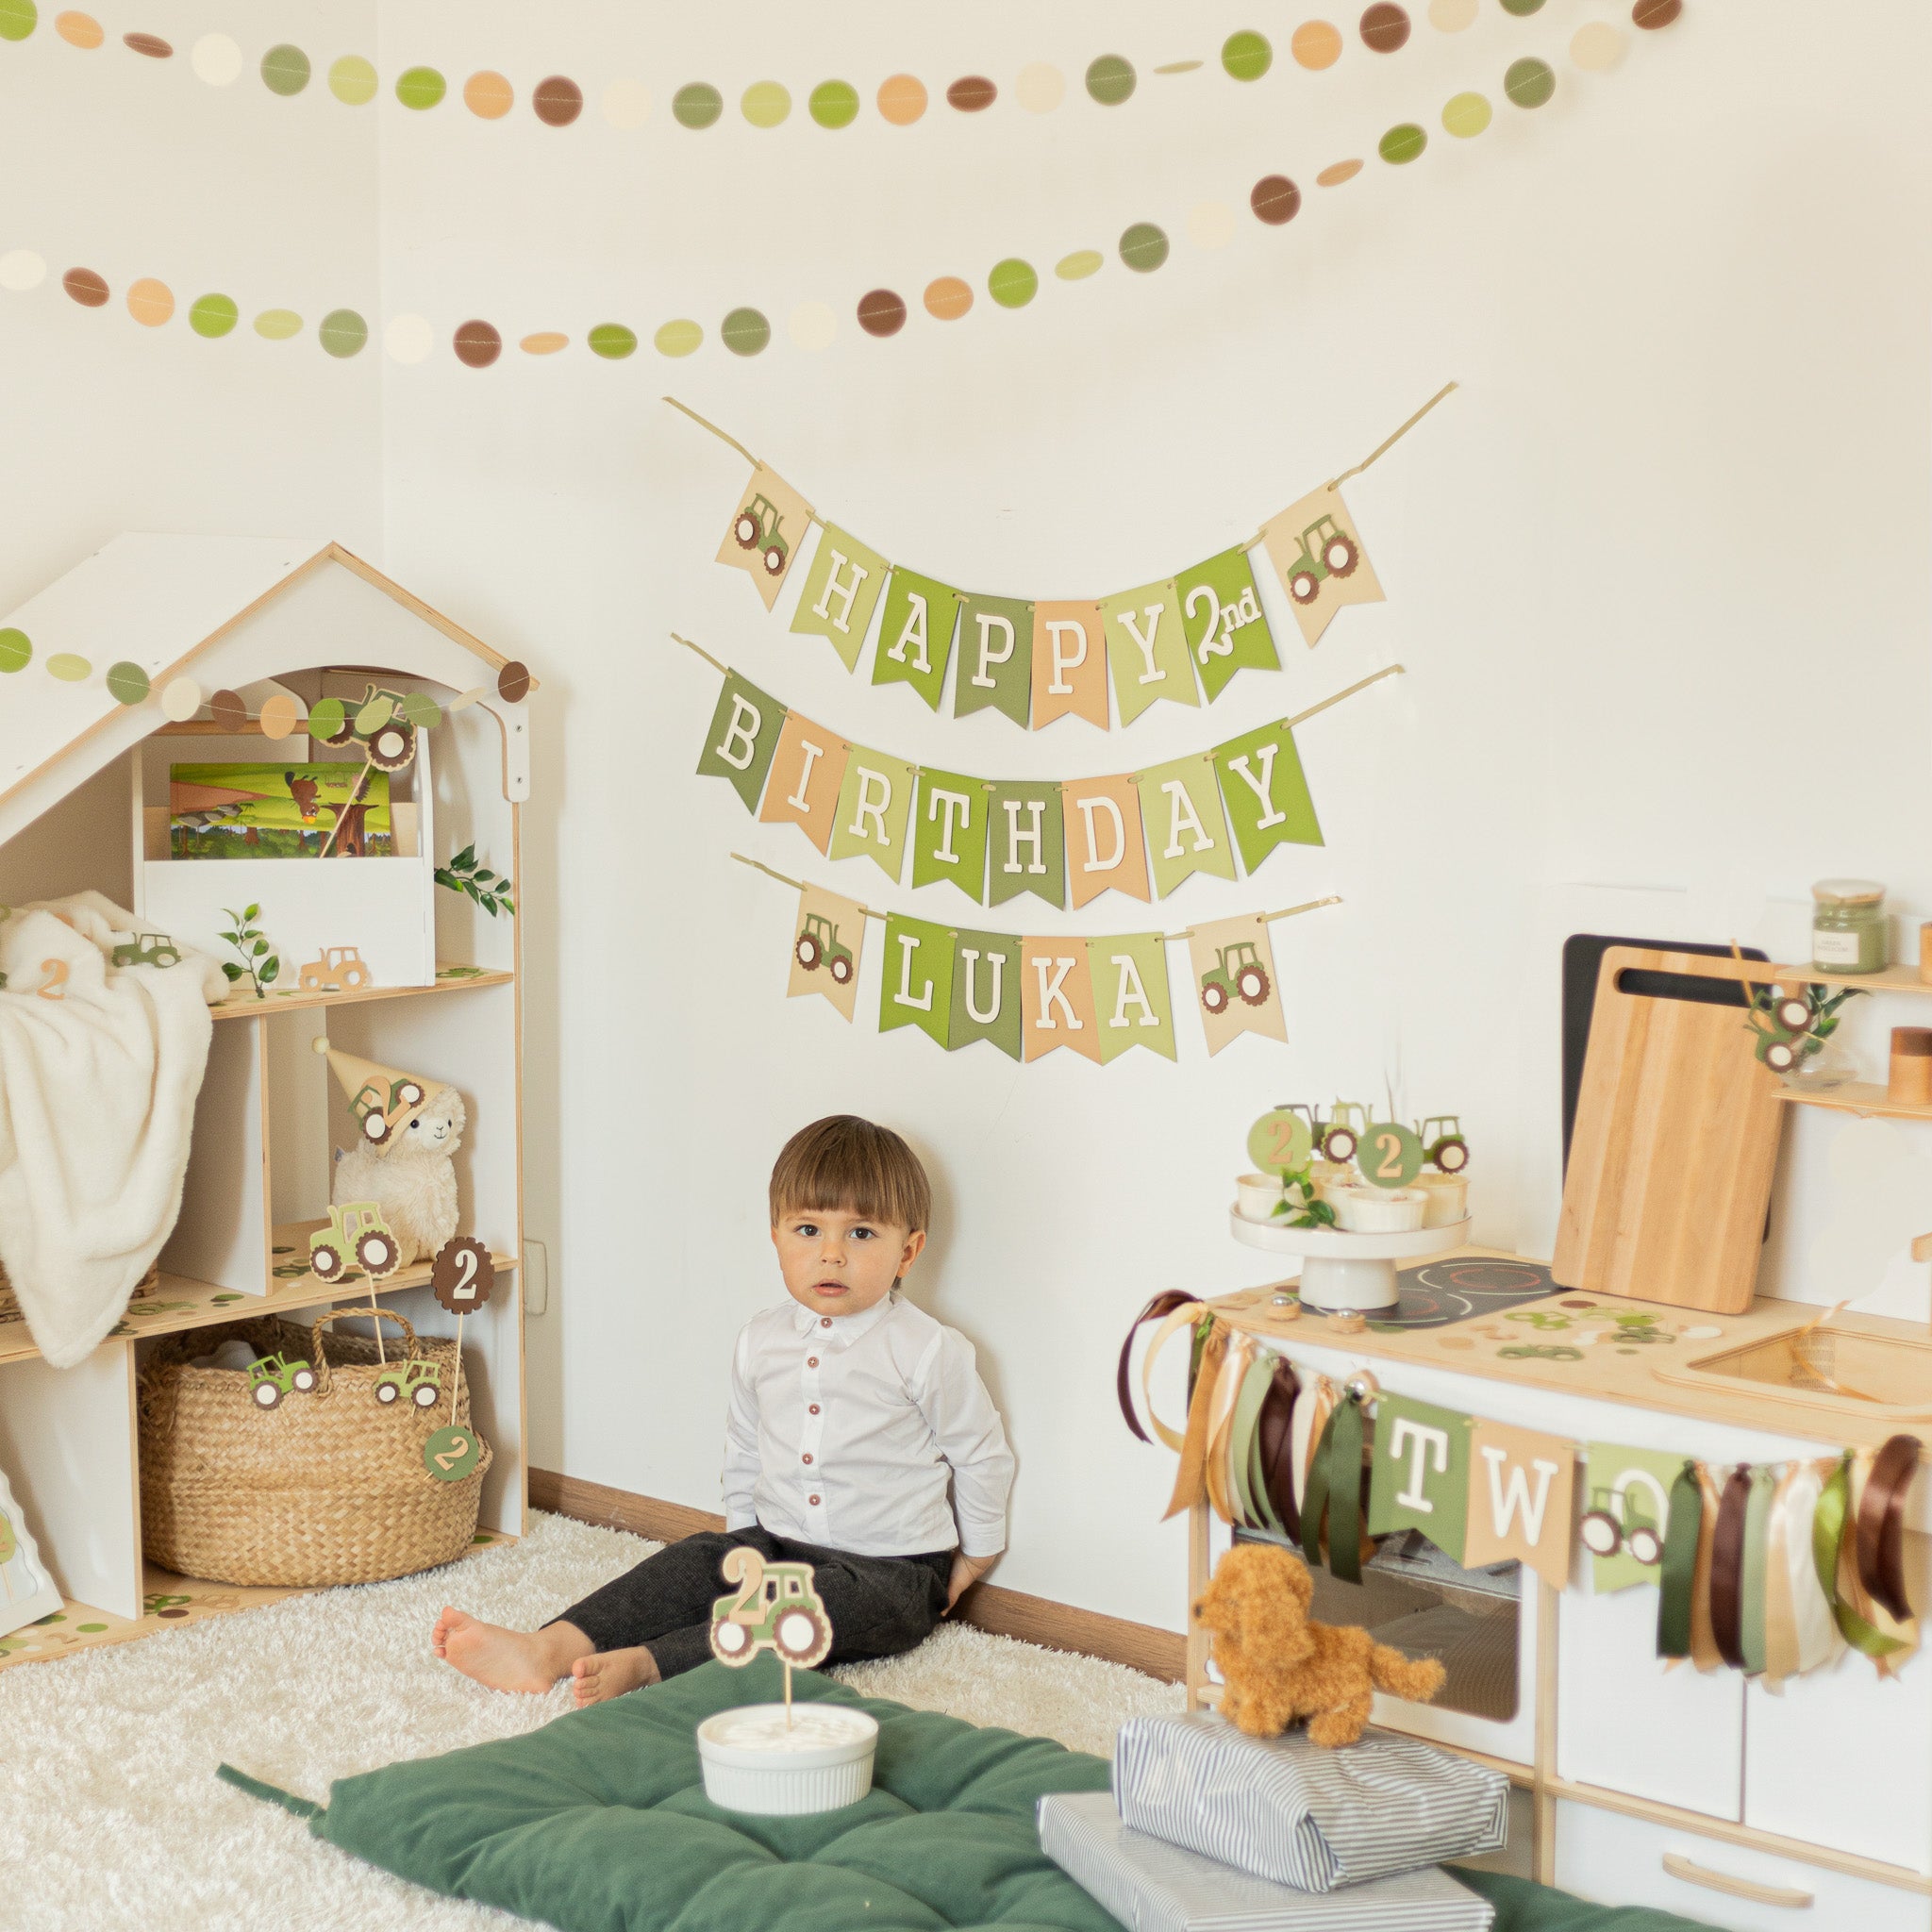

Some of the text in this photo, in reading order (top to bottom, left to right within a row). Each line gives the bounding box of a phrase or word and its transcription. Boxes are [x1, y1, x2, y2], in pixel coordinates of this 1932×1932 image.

[812, 549, 1262, 694] HAPPY 2nd
[716, 692, 1286, 874] BIRTHDAY
[37, 958, 69, 1000] 2
[893, 935, 1160, 1030] LUKA
[360, 1075, 411, 1127] 2
[1267, 1120, 1292, 1165] 2
[1375, 1133, 1403, 1178] 2
[453, 1249, 478, 1300] 2
[434, 1436, 469, 1471] 2
[725, 1550, 767, 1625] 2
